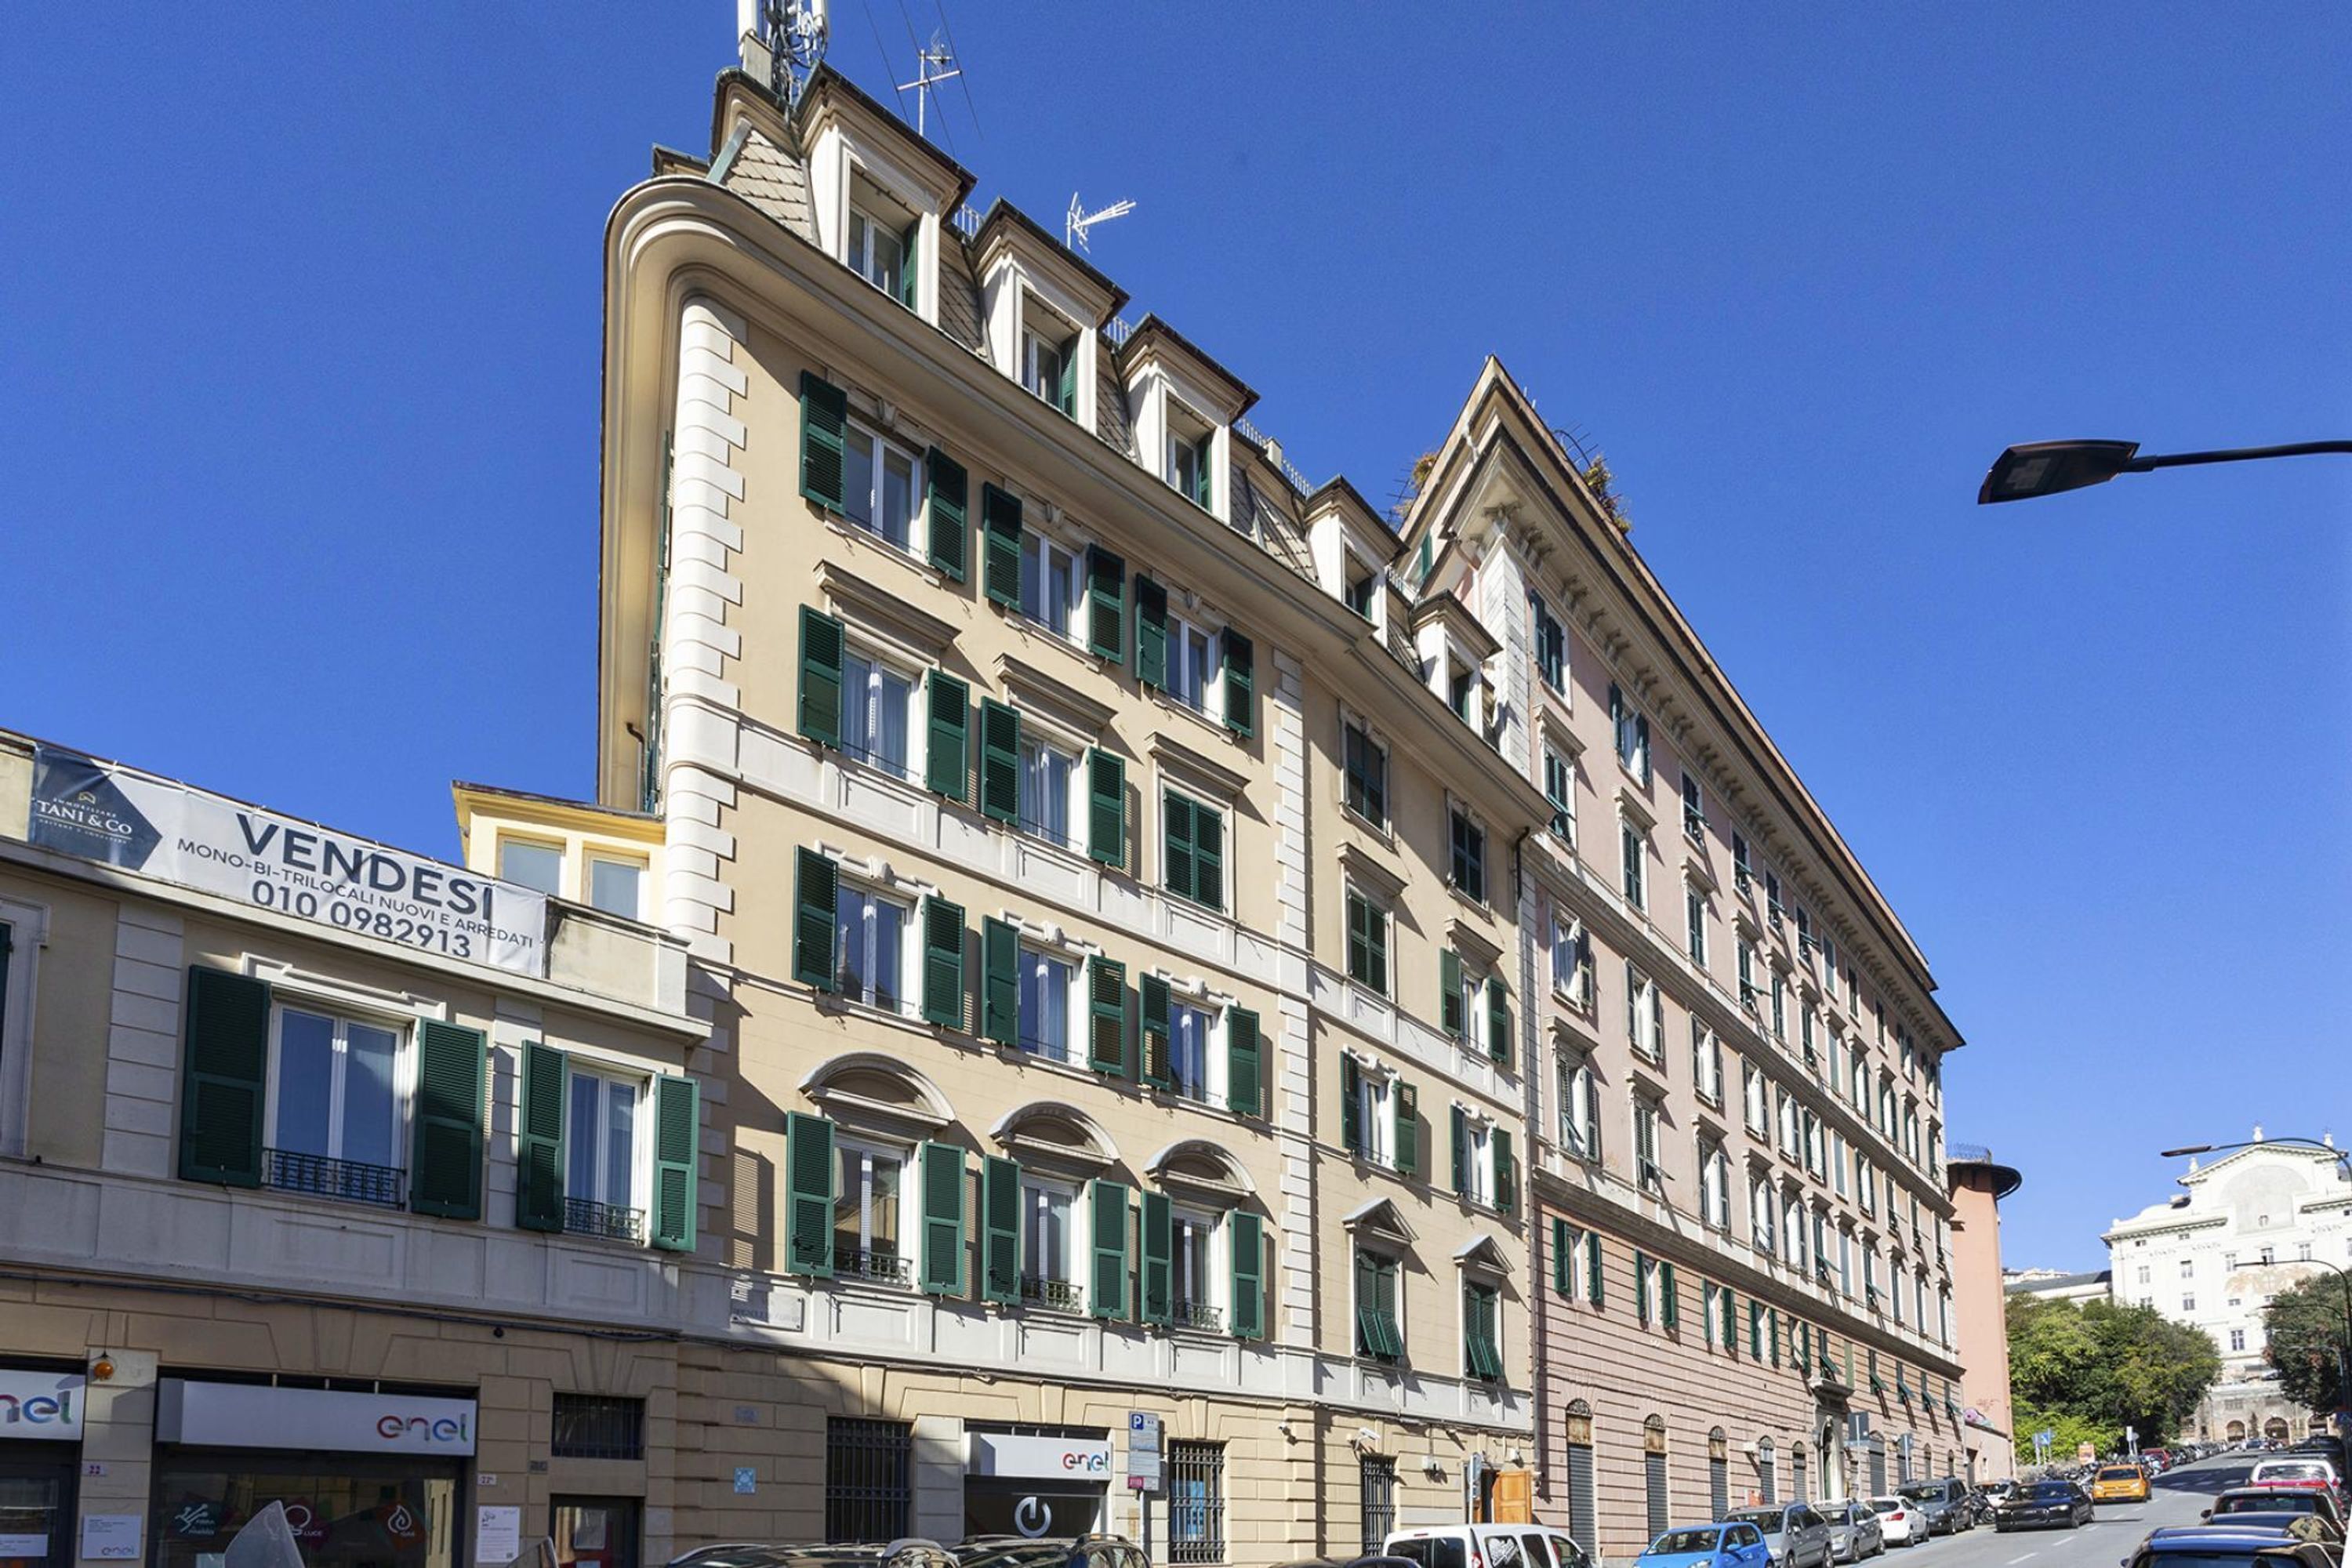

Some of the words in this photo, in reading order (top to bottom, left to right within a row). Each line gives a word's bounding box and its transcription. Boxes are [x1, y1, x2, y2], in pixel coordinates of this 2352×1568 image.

[37, 800, 84, 822] TANI
[88, 815, 103, 828] &
[236, 812, 492, 920] VENDESI
[177, 838, 374, 905] MONO-BI-TRILOCALI
[379, 895, 435, 922] NUOVI
[440, 913, 451, 927] E
[455, 917, 533, 949] ARREDATI
[252, 880, 318, 918] 010
[330, 901, 471, 959] 0982913
[376, 1413, 468, 1442] enel
[1062, 1450, 1109, 1472] enel
